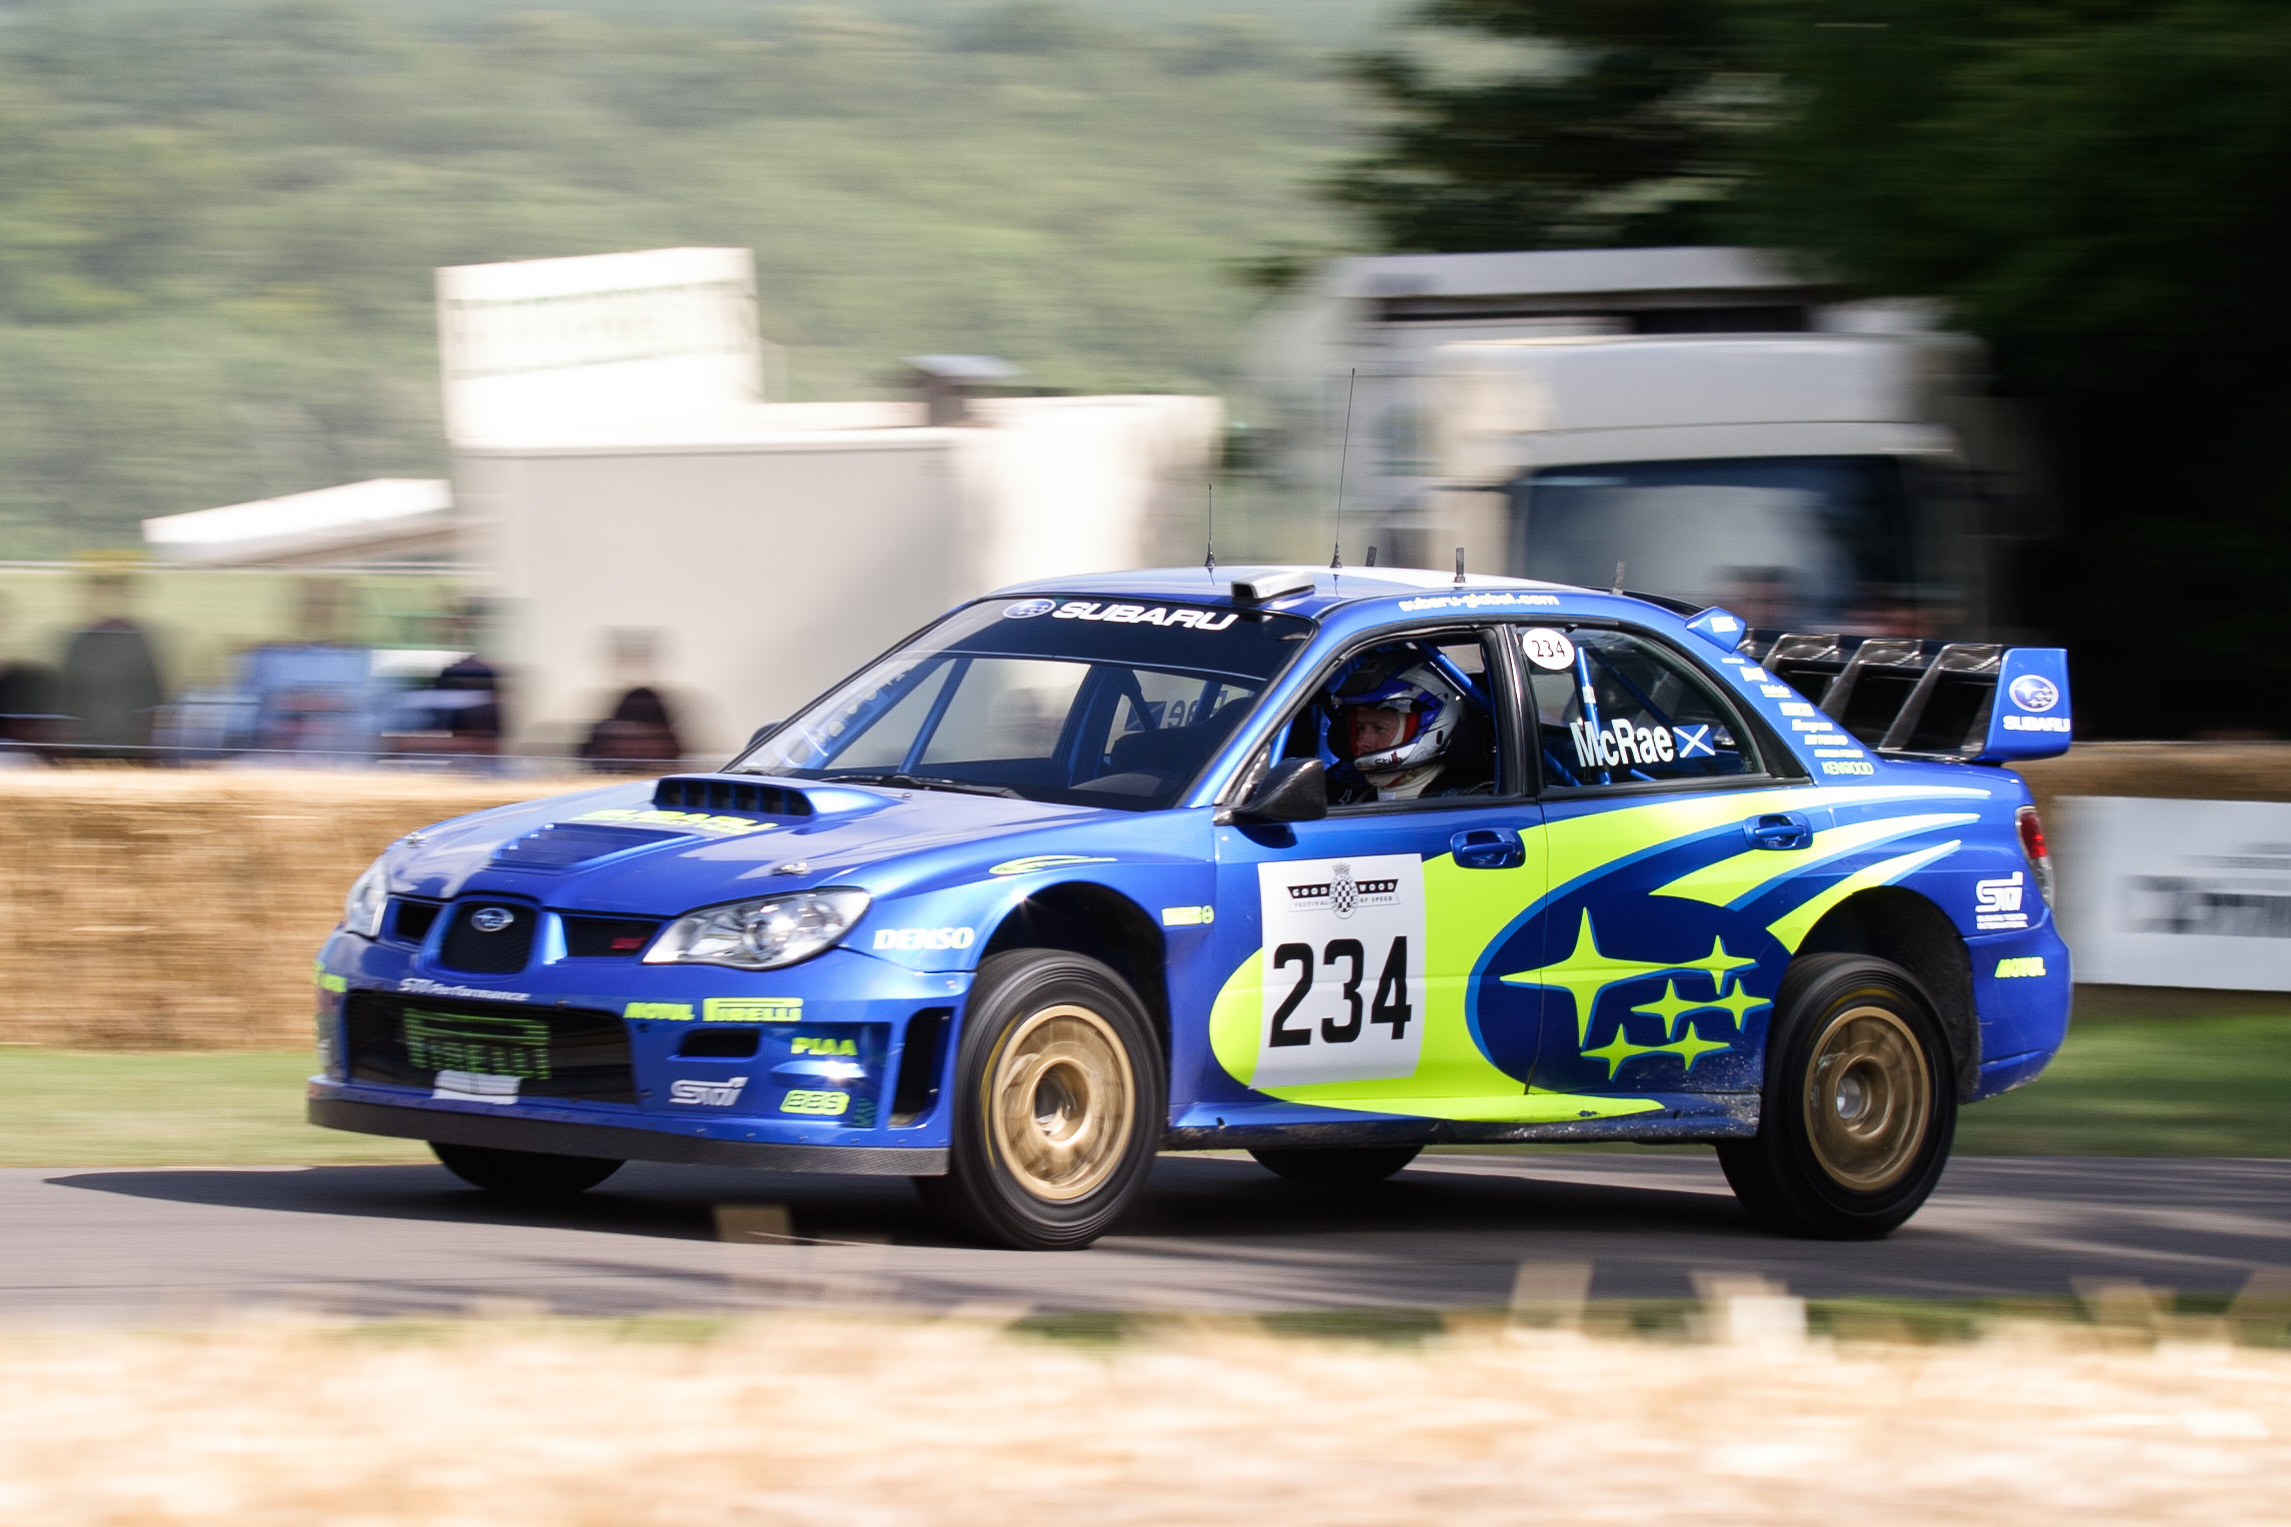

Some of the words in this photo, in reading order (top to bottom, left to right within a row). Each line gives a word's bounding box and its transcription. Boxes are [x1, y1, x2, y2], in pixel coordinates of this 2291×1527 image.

[1052, 602, 1239, 631] SUBARU
[1531, 639, 1566, 658] 234
[2002, 715, 2071, 732] SUBARU
[1569, 718, 1675, 768] McRae
[1821, 761, 1875, 775] KENWOOD
[1371, 895, 1393, 903] SPEED
[872, 926, 975, 950] DENSO
[1994, 957, 2047, 978] MOTUL
[1268, 936, 1412, 1048] 234
[623, 1002, 695, 1021] MOTUL
[702, 997, 804, 1022] PIRELLI
[790, 1037, 859, 1056] PIAA
[779, 1089, 850, 1115] BBS
